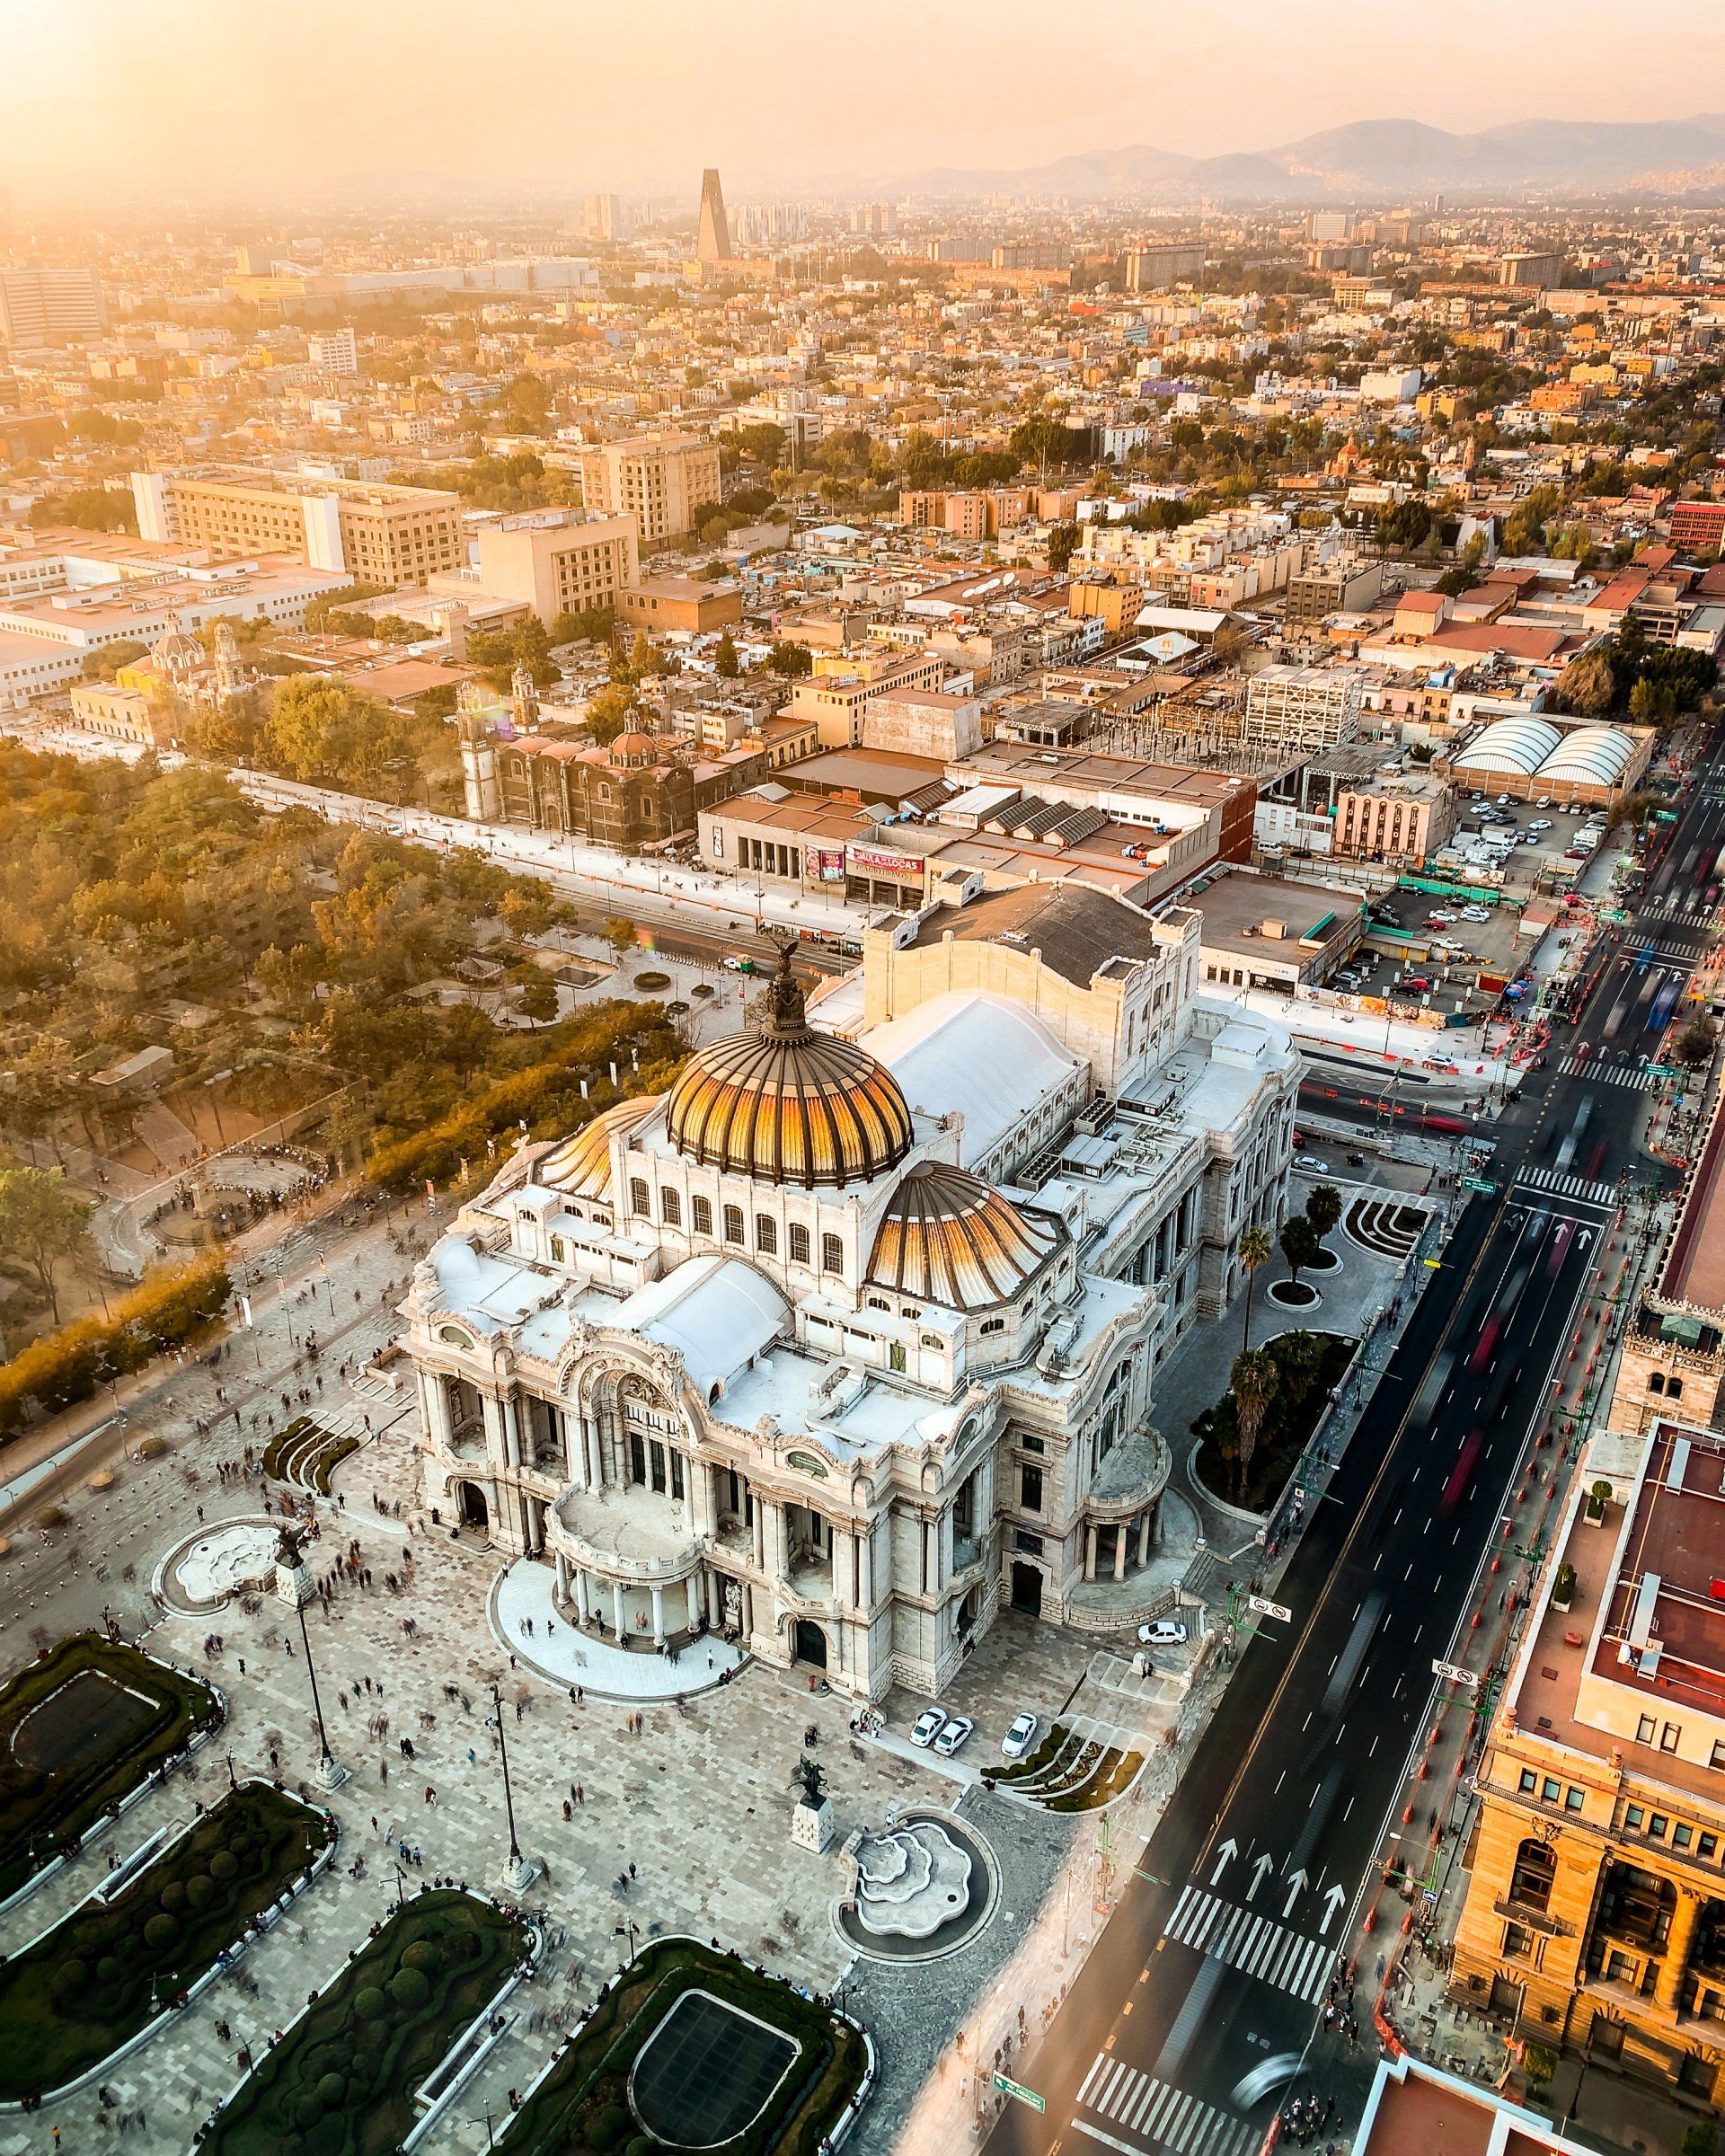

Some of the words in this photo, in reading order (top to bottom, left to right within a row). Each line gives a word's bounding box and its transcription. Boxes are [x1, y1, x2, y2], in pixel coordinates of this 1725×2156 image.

[858, 852, 880, 864] JAULA
[889, 858, 917, 870] LOCAS
[882, 869, 913, 881] HIDALGO
